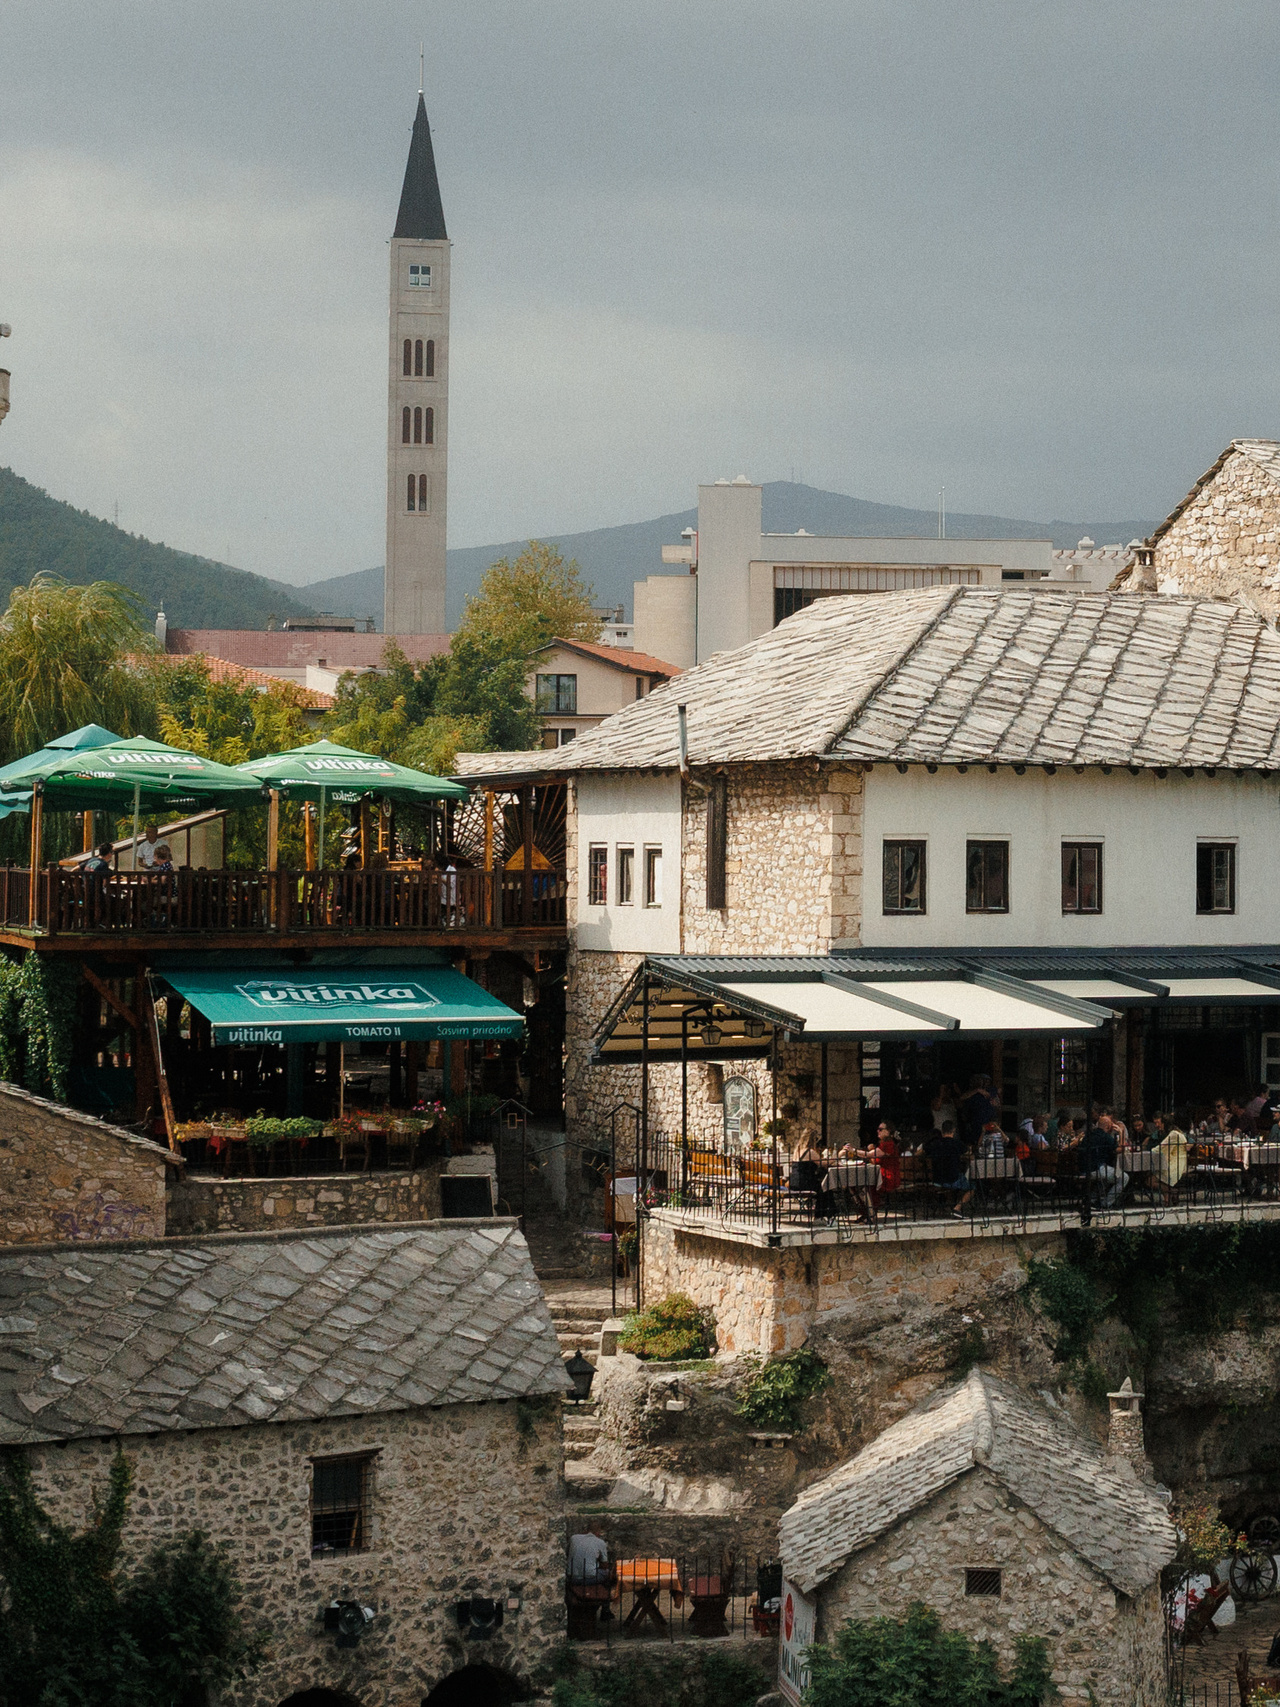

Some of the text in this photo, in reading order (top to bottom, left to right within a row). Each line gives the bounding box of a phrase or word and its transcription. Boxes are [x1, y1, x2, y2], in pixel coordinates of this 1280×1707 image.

[107, 753, 201, 764] vitinka
[305, 758, 391, 770] vitinka
[260, 986, 417, 1002] vitinka
[229, 1028, 282, 1041] vitinka
[345, 1027, 391, 1036] TOMATO
[437, 1025, 512, 1037] Sasvim prirodno
